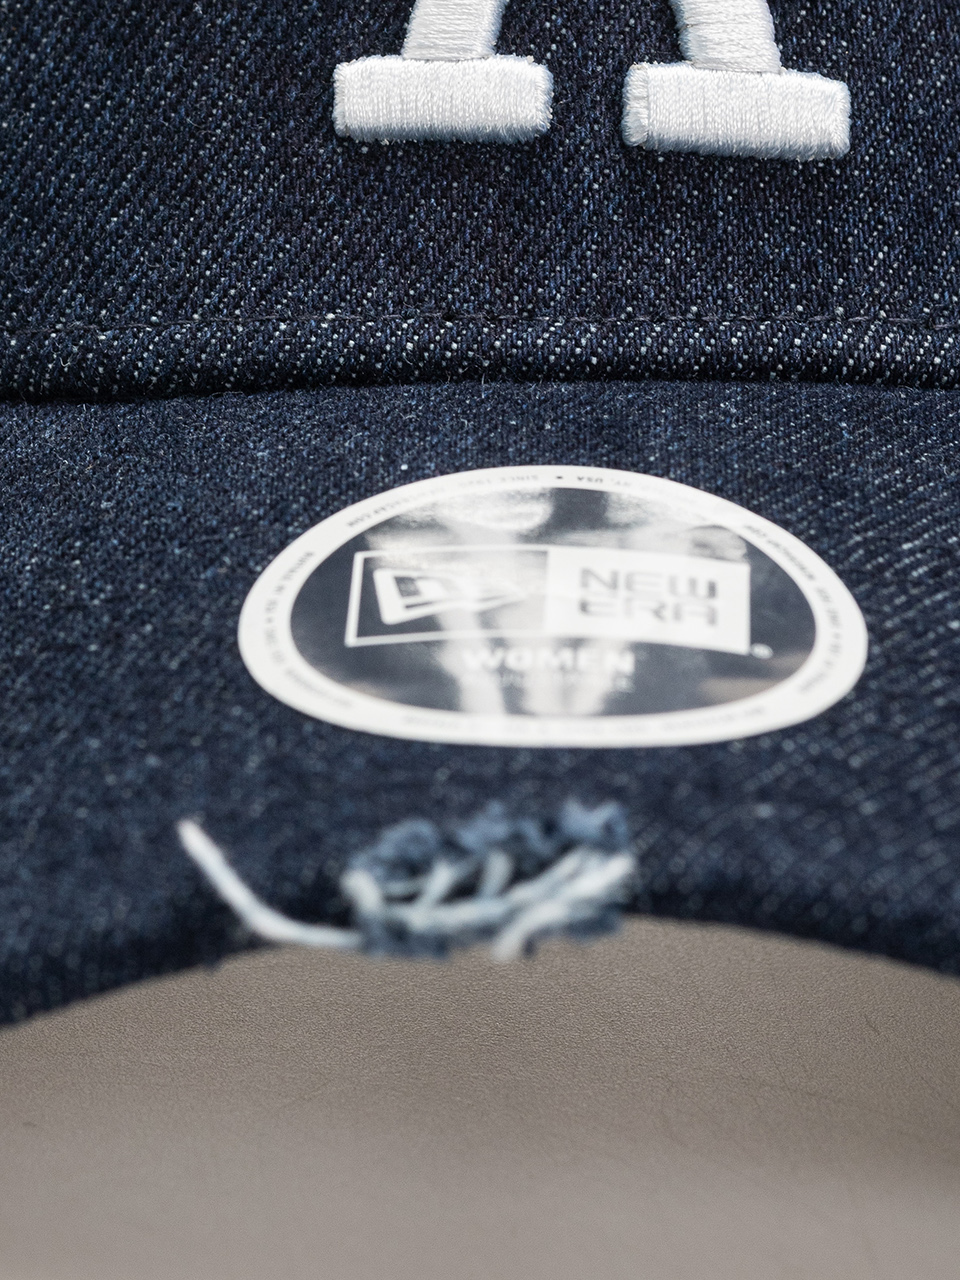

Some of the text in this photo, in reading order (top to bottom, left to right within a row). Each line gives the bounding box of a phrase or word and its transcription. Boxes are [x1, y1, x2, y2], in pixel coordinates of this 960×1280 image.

[576, 475, 604, 485] USA
[579, 567, 718, 599] NEW
[462, 646, 636, 673] WOMEN
